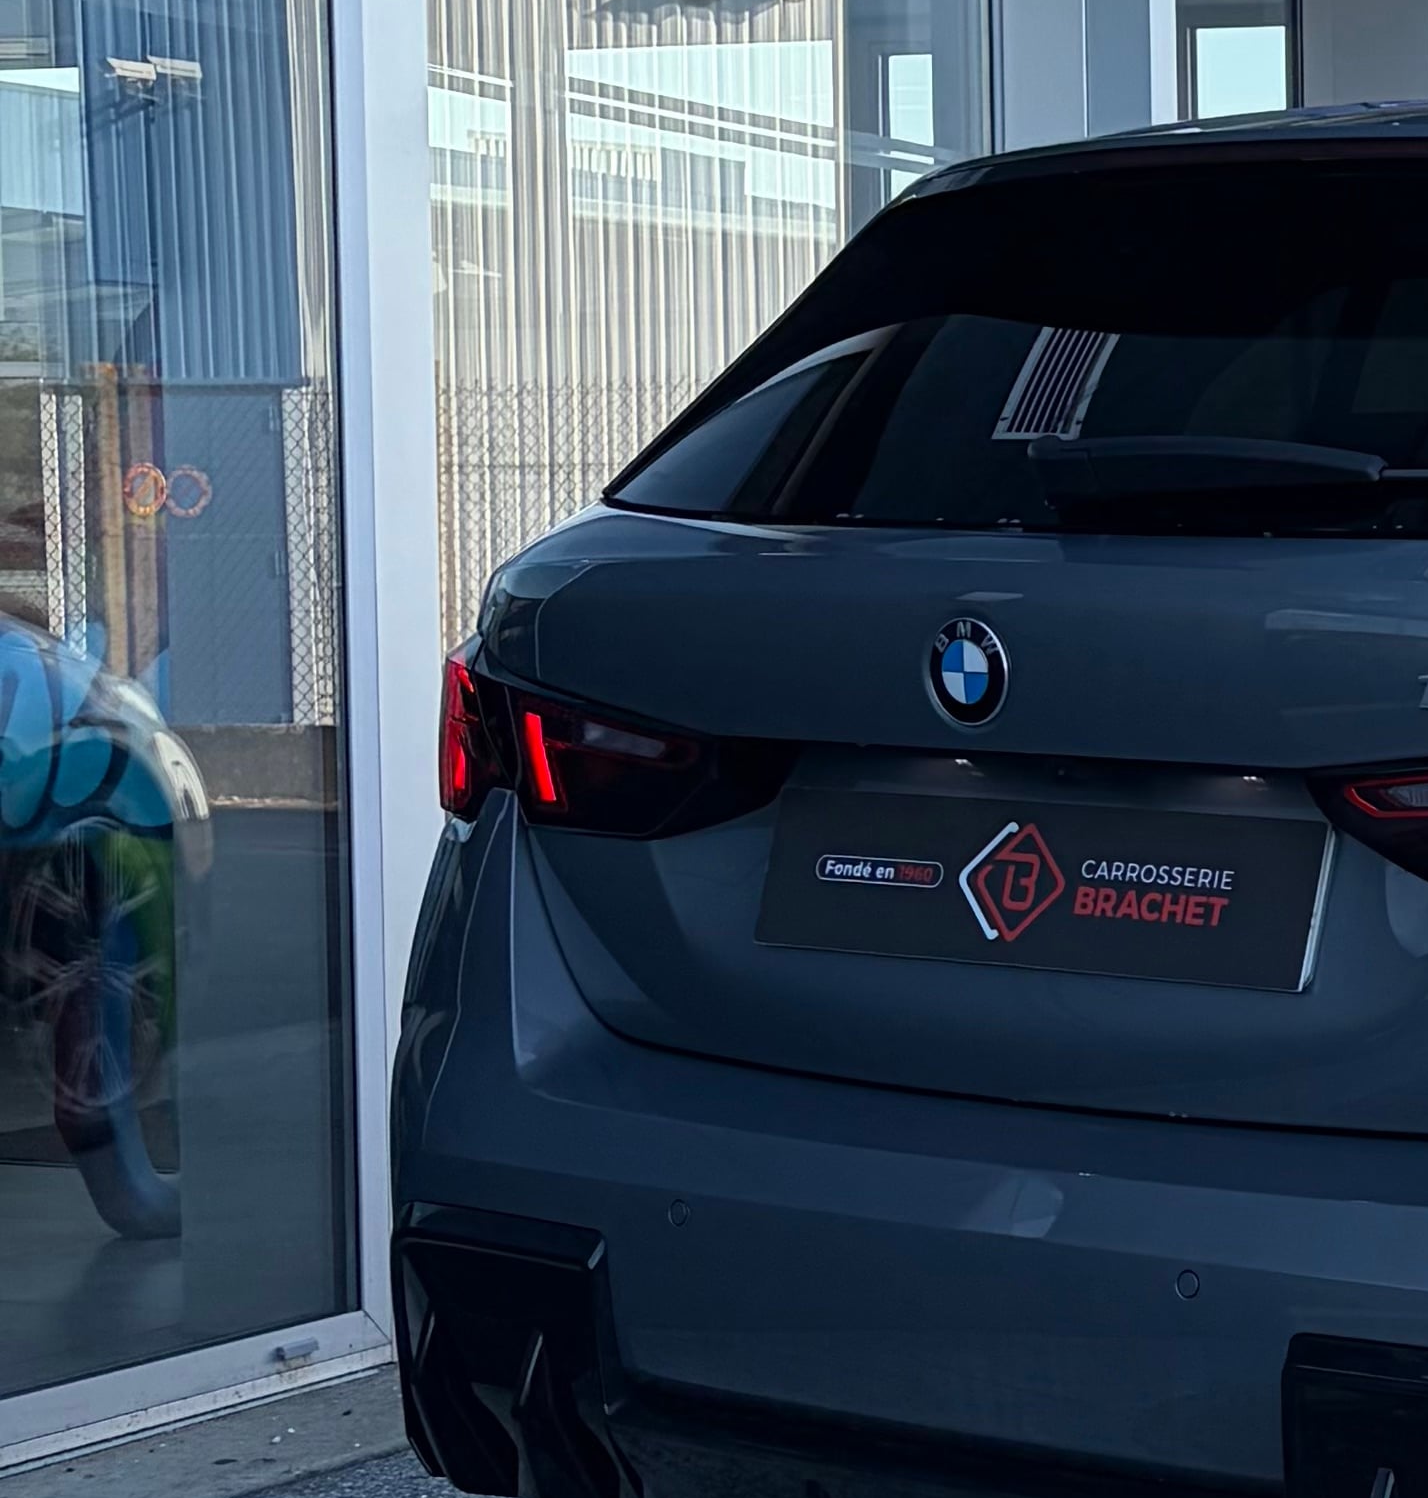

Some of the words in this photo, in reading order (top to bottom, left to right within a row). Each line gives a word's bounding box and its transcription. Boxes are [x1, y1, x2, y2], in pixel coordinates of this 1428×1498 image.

[934, 620, 1000, 656] BMW
[824, 859, 872, 879] Fondé
[875, 865, 895, 880] en
[1081, 859, 1236, 891] CARROSSERIE
[1073, 885, 1230, 927] BRACHET
